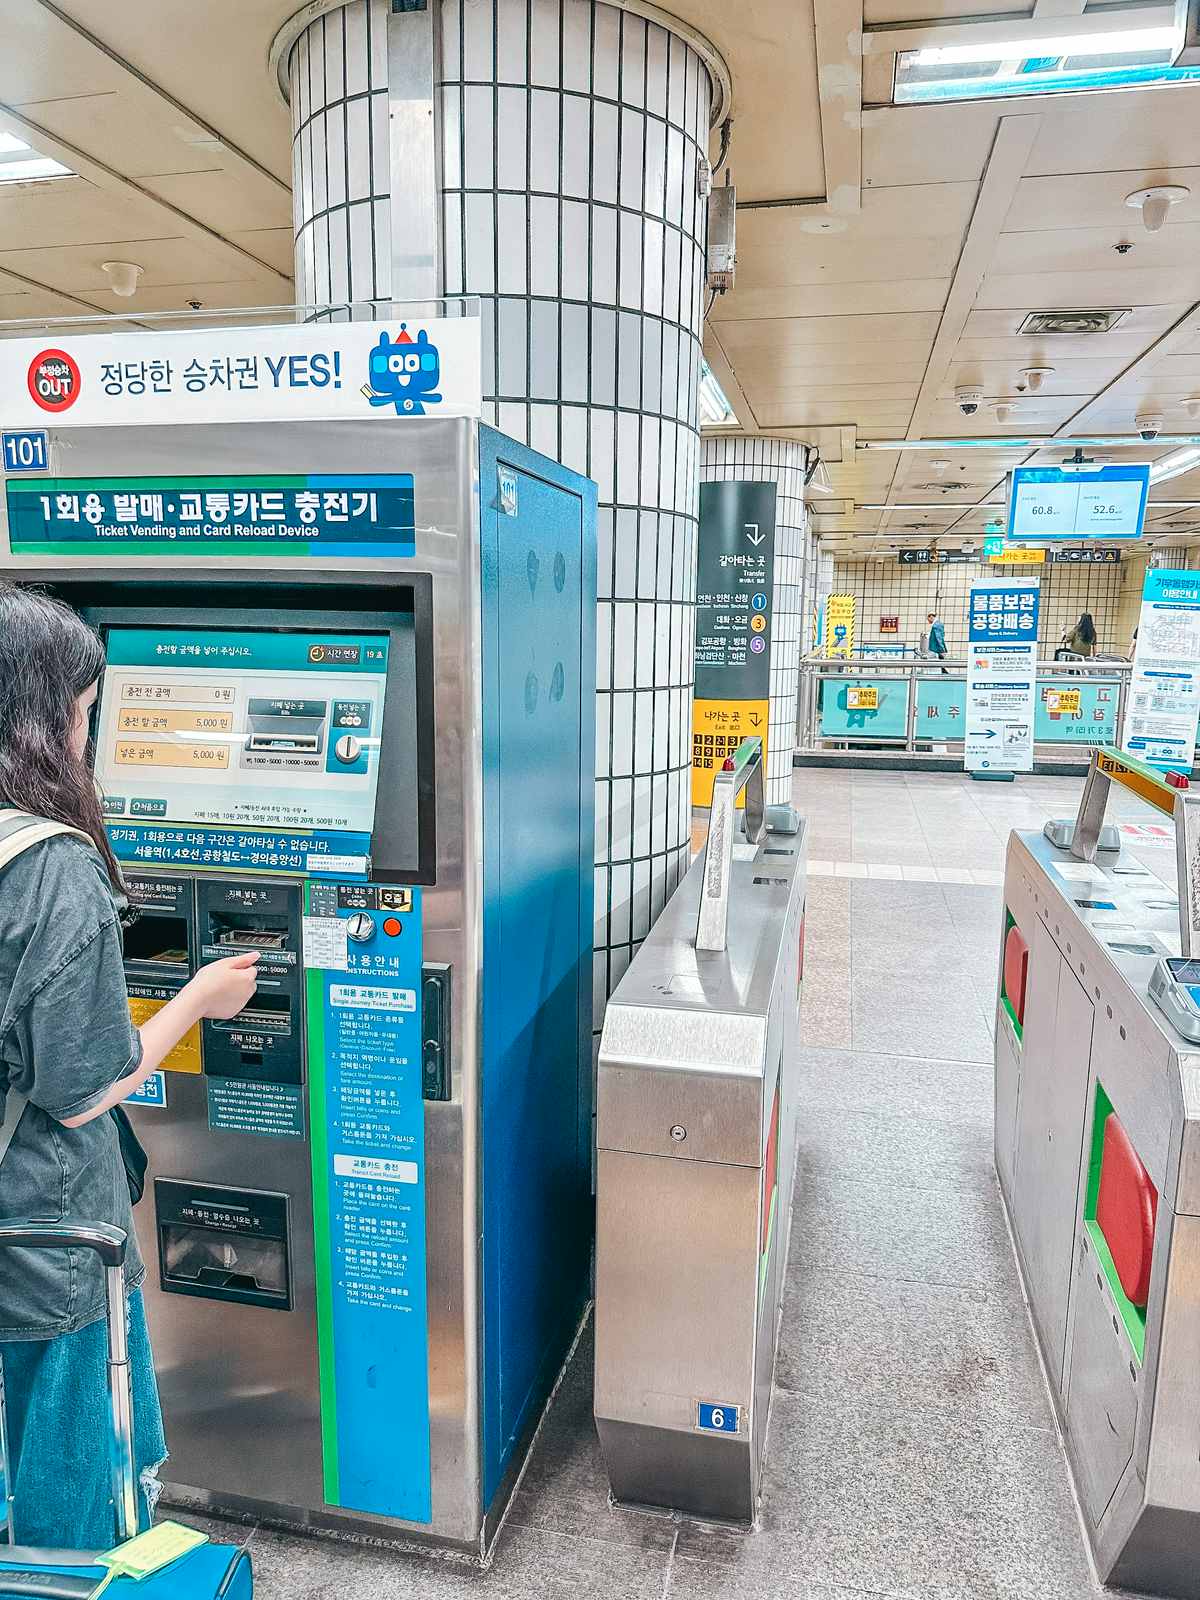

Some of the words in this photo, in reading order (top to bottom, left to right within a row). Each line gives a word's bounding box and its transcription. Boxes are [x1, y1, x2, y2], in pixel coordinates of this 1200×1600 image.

[100, 359, 173, 395] 정당한
[183, 356, 259, 392] 승차권
[265, 350, 342, 389] YES!
[39, 379, 71, 396] OUT
[6, 437, 44, 467] 101
[40, 495, 105, 523] 1회용
[114, 493, 287, 523] 발매·교통카드
[295, 491, 377, 522] 충전기
[1032, 506, 1052, 515] 60.8
[1094, 505, 1115, 514] 52.6
[95, 523, 128, 537] Ticket
[129, 524, 177, 538] Vending
[179, 524, 200, 536] and
[204, 524, 231, 536] Card
[234, 524, 276, 536] Reload
[279, 524, 320, 536] Device
[720, 555, 754, 566] 갈아타는
[757, 597, 761, 607] 1
[974, 594, 1035, 611] 물품보관
[756, 619, 761, 629] 3
[973, 613, 1034, 630] 공항배송
[755, 640, 760, 650] 5
[327, 649, 341, 658] 시간
[127, 687, 143, 697] 충전
[145, 687, 154, 698] 전
[155, 687, 170, 698] 금액
[222, 690, 231, 699] 원
[123, 716, 139, 727] 충전
[152, 717, 168, 728] 금액
[704, 711, 729, 722] 나가는
[731, 712, 740, 722] 곳
[197, 718, 217, 728] 5,000
[219, 718, 228, 729] 원
[120, 747, 137, 759] 넣은
[138, 748, 154, 759] 금액
[193, 750, 214, 760] 5,000
[111, 830, 140, 843] 정기권,
[143, 831, 184, 844] 1회용으로
[187, 833, 205, 845] 다음
[208, 835, 235, 847] 구간은
[238, 836, 276, 849] 갈아타실
[278, 839, 287, 850] 수
[291, 840, 330, 853] 없습니다.
[711, 1408, 724, 1428] 6
